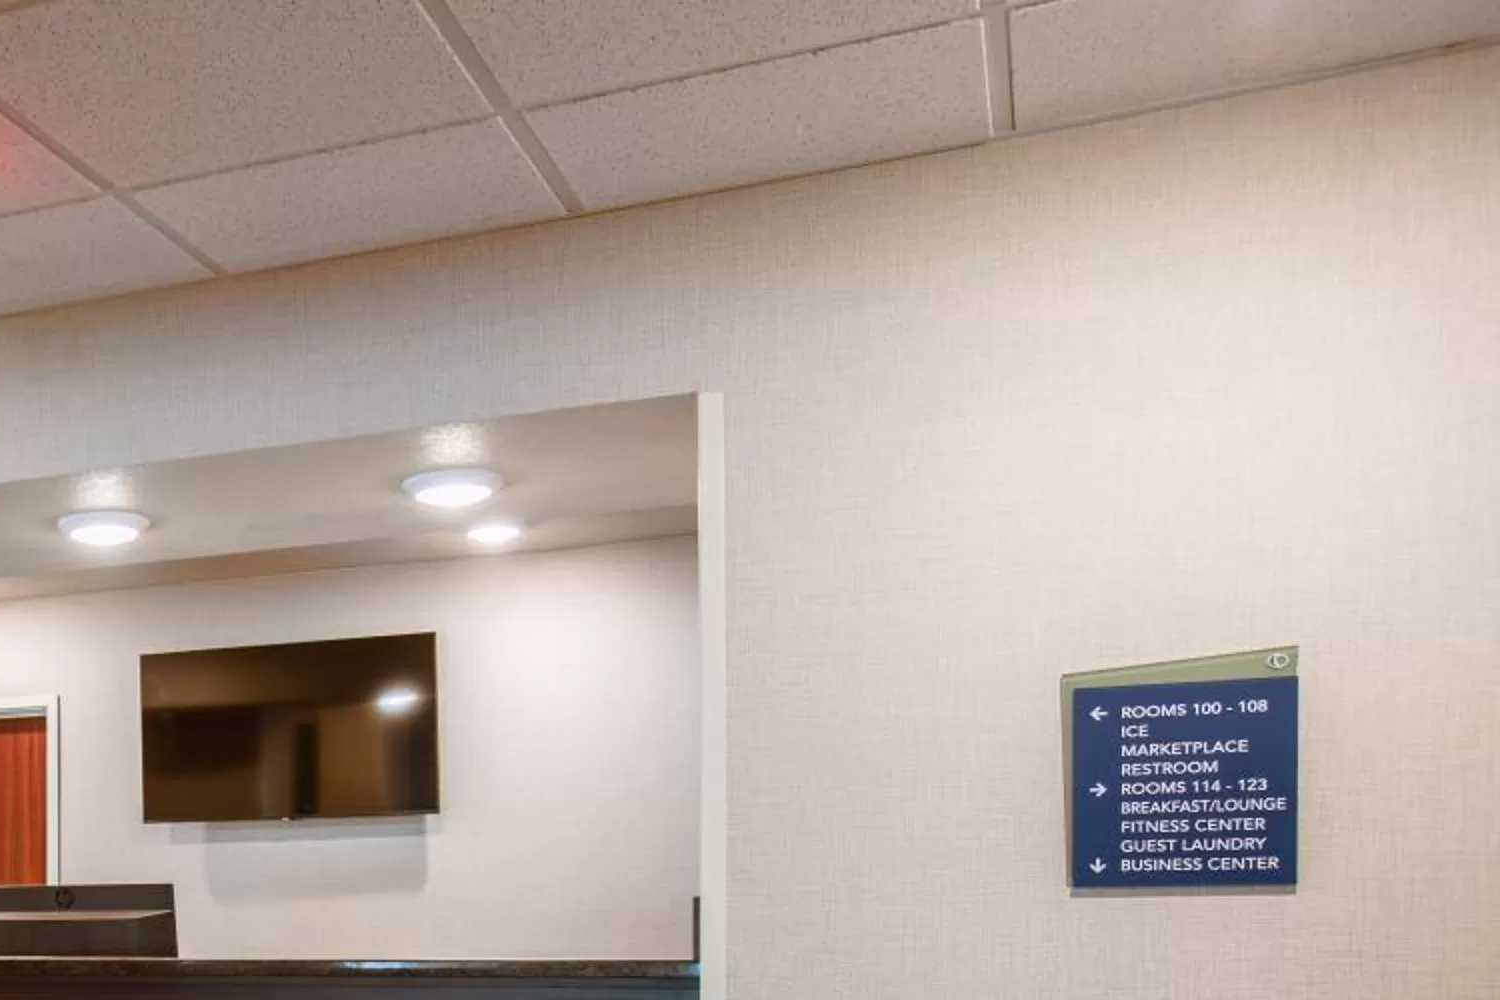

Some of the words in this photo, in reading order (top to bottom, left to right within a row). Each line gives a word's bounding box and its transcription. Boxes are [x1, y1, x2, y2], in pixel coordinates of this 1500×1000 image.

[1120, 703, 1187, 719] ROOMS
[1193, 701, 1223, 716] 100
[1239, 699, 1269, 713] 108
[1120, 724, 1149, 738] ICE
[1120, 739, 1249, 757] MARKETPLACE
[1120, 760, 1219, 777] RESTROOM
[1120, 781, 1187, 796] ROOMS
[1192, 779, 1222, 793] 114
[1238, 777, 1269, 792] 123
[1120, 797, 1288, 815] BREAKFAST/LOUNGE
[1120, 819, 1191, 833] FITNESS
[1194, 817, 1267, 832] CENTER
[1120, 839, 1177, 853] GUEST
[1181, 837, 1267, 851] LAUNDRY
[1120, 857, 1203, 872] BUSINESS
[1207, 856, 1280, 871] CENTER
